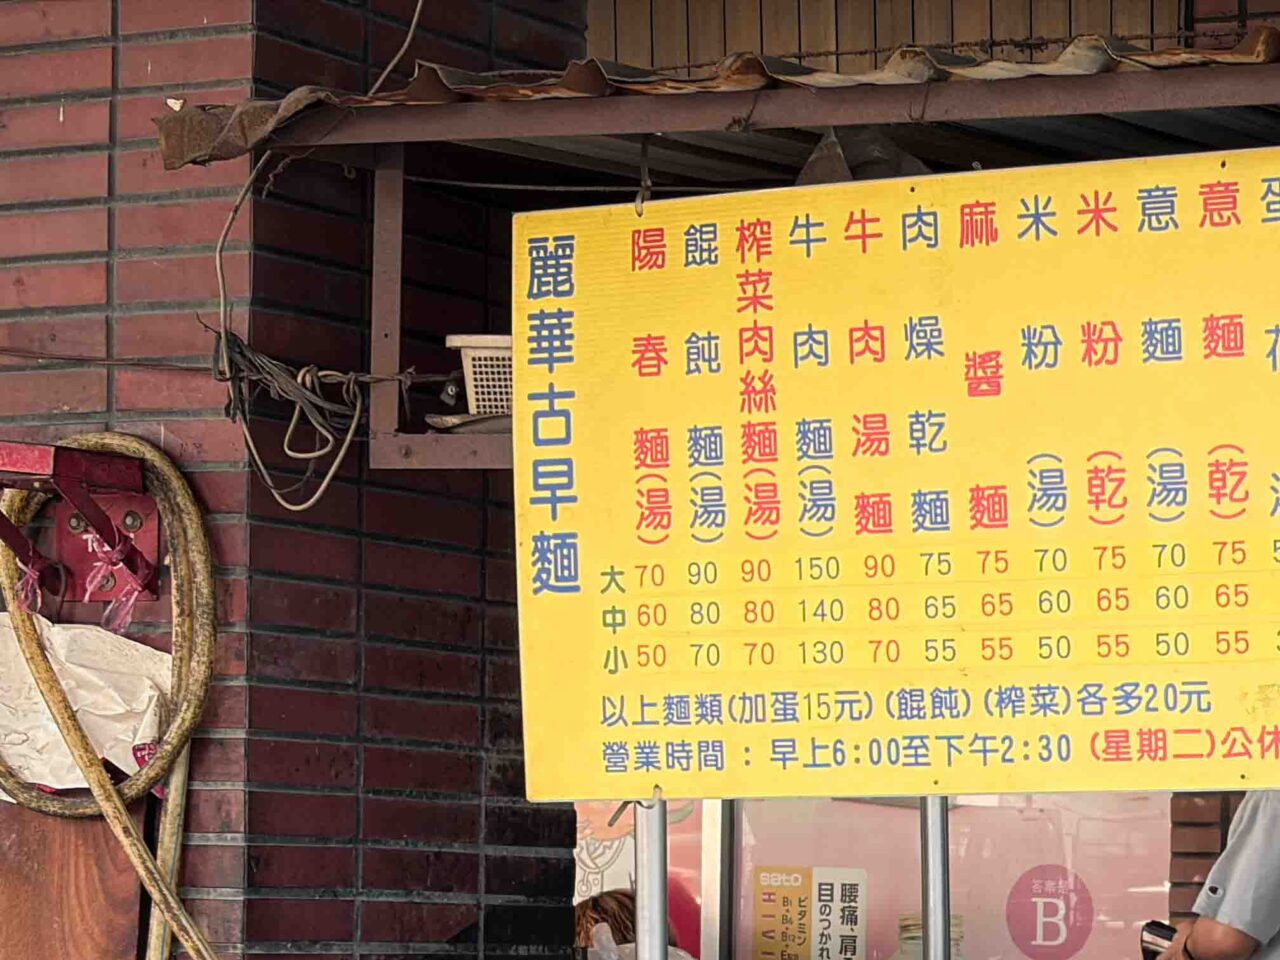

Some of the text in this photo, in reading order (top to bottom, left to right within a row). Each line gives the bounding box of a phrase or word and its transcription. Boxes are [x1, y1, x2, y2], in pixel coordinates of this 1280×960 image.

[526, 234, 582, 596] 麗華古早麵
[631, 228, 672, 545] 陽春麵(湯)
[684, 223, 727, 544] 餛飩麵(湯)
[736, 218, 781, 541] 榨菜肉絲麵(湯)
[789, 213, 836, 538] 牛肉麵(湯)
[844, 208, 893, 535] 牛肉湯麵
[902, 205, 950, 533] 肉燥乾麵
[959, 200, 1008, 530] 麻醬麵
[1017, 194, 1067, 528] 米粉(湯)
[1077, 190, 1127, 525] 米粉(乾)
[1136, 185, 1188, 523] 意麵(湯)
[1199, 181, 1249, 519] 意麵(乾)
[600, 565, 626, 594] 大
[635, 564, 664, 587] 70
[688, 561, 717, 585] 90
[741, 559, 771, 582] 90
[795, 556, 839, 580] 150
[864, 554, 895, 578] 90
[920, 552, 951, 576] 75
[977, 550, 1008, 574] 75
[1034, 548, 1067, 572] 70
[1093, 546, 1126, 570] 75
[1152, 543, 1185, 568] 70
[1213, 540, 1246, 565] 75
[602, 584, 1248, 635] 中 60 80 80 140 80 65 65 60 65 60 65
[604, 646, 628, 674] 小
[638, 644, 666, 667] 50
[690, 643, 720, 666] 70
[744, 642, 774, 665] 70
[799, 641, 843, 664] 130
[869, 640, 900, 663] 70
[925, 639, 956, 662] 55
[982, 637, 1013, 660] 55
[1039, 635, 1070, 659] 50
[1097, 634, 1129, 658] 55
[1156, 632, 1189, 656] 50
[1216, 631, 1249, 655] 55
[760, 873, 802, 886] sato
[818, 883, 834, 960] 目のつかれ
[1031, 897, 1067, 945] B
